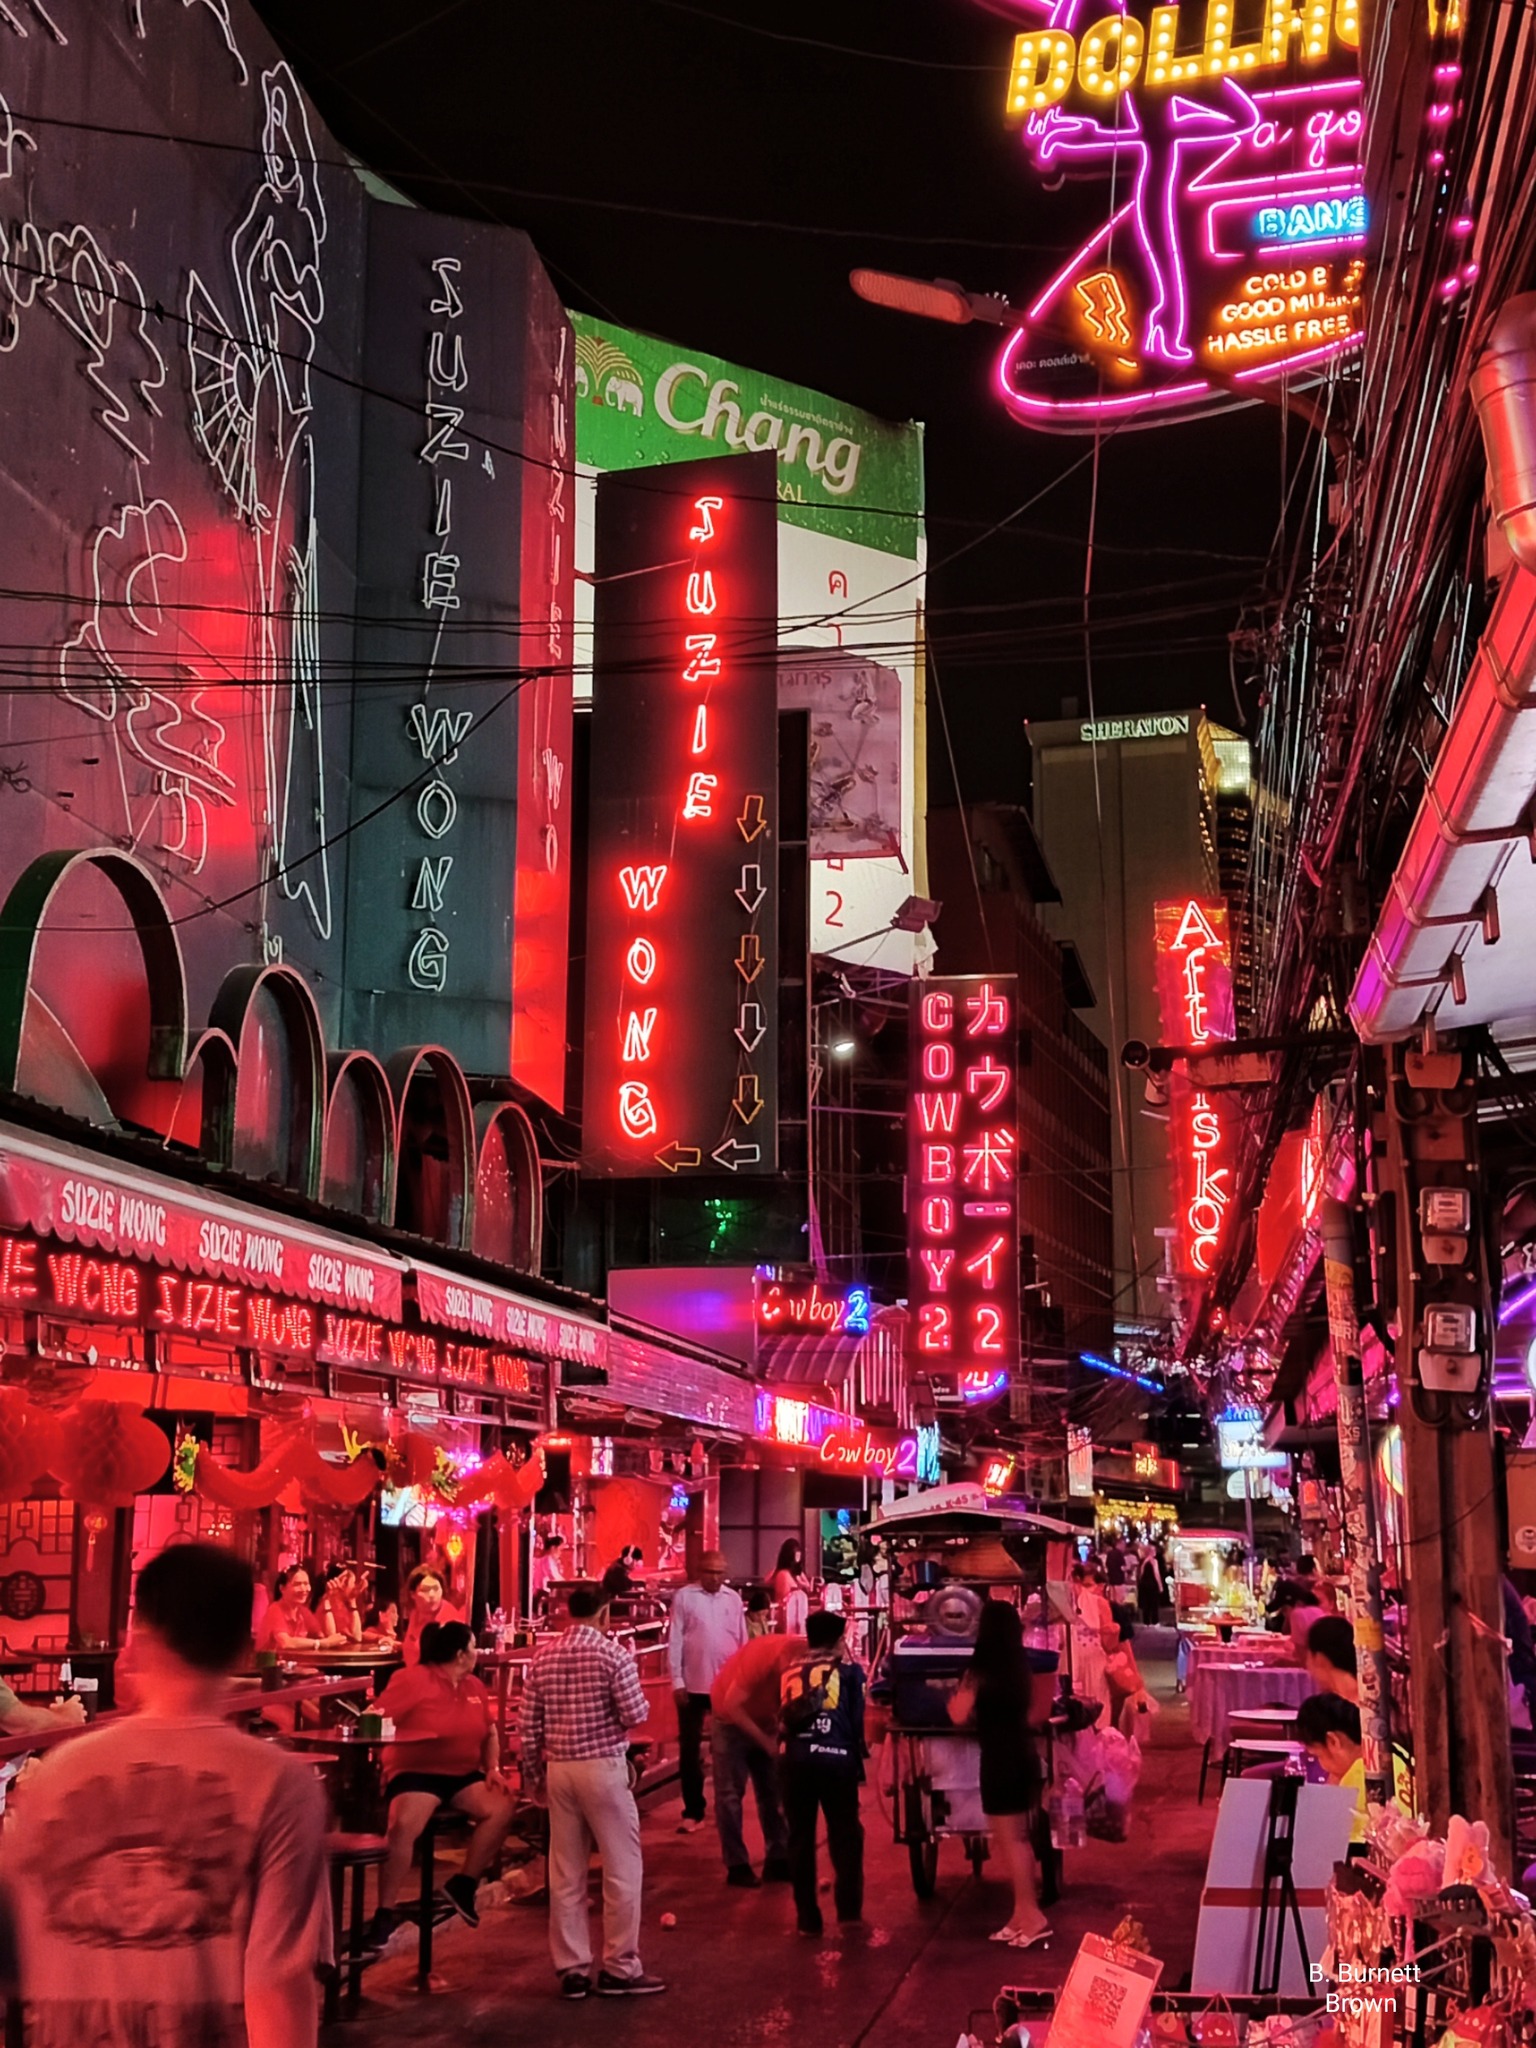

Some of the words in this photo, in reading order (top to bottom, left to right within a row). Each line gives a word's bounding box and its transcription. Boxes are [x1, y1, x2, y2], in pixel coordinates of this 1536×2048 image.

[1246, 270, 1307, 294] COLD
[1208, 324, 1289, 354] HASSLE
[1294, 314, 1352, 341] FREE
[1222, 297, 1286, 323] GOOD
[420, 258, 470, 611] SUZIE
[653, 361, 862, 494] Chang
[683, 496, 723, 819] SUZIE
[1080, 715, 1190, 742] SHERATON
[410, 704, 473, 990] WONG
[825, 890, 844, 928] 2
[618, 865, 668, 1139] WONG
[914, 992, 961, 1293] COWBOY
[963, 983, 1017, 1291] カウボーイ
[62, 1179, 116, 1233] SUZIE
[119, 1195, 166, 1247] WONG
[200, 1219, 243, 1268] SUZIE
[243, 1233, 284, 1279] WONG
[344, 1262, 375, 1304] WONG
[762, 1284, 845, 1332] Cwboy
[843, 1289, 869, 1332] 2
[973, 1304, 1004, 1354] 2
[820, 1432, 898, 1476] Cowboy
[896, 1439, 917, 1472] 2
